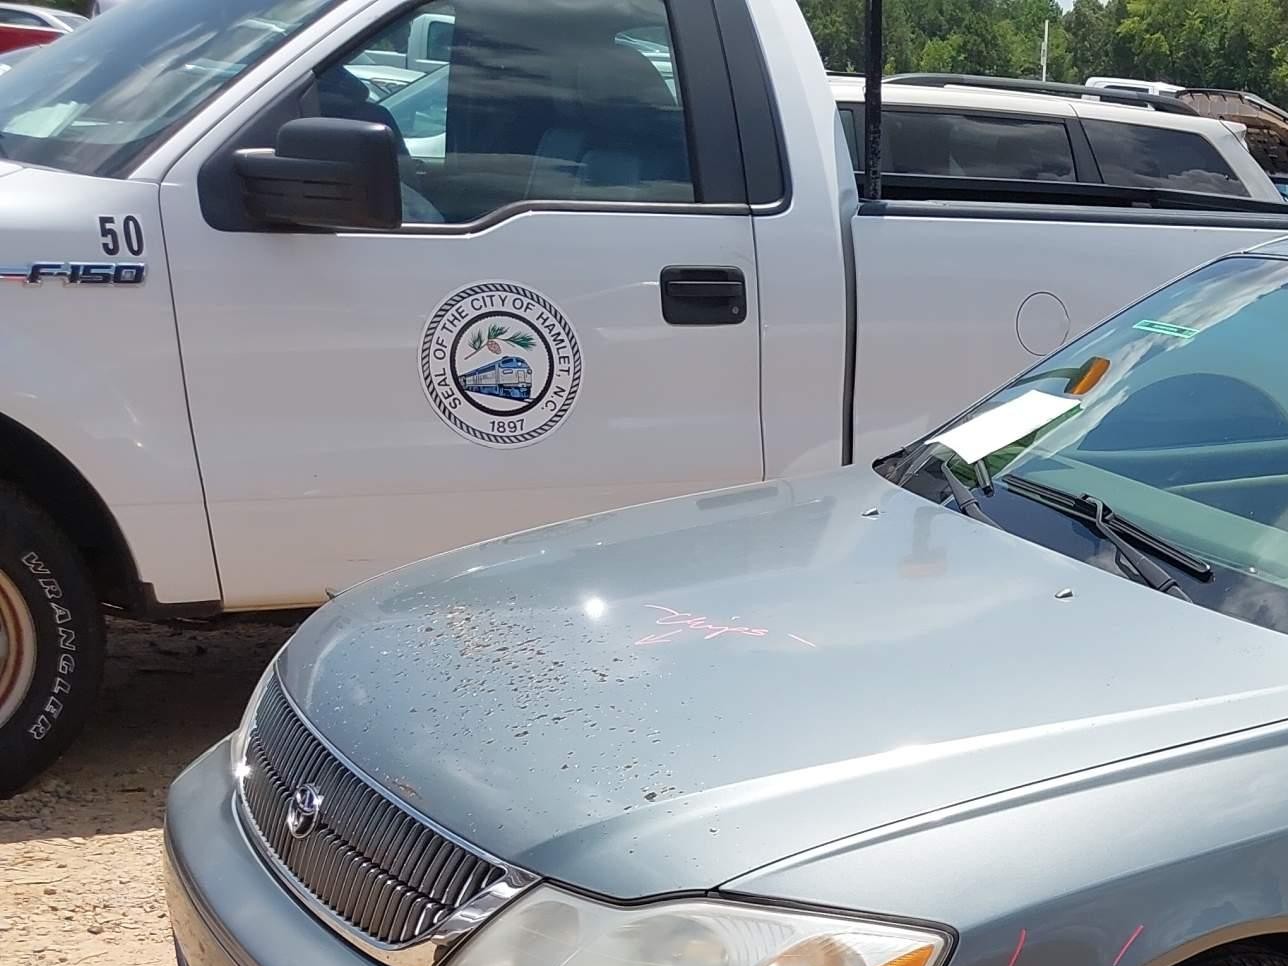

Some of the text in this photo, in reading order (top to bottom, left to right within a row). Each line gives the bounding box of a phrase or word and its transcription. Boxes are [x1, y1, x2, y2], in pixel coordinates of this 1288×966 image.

[98, 215, 144, 256] 50
[433, 294, 571, 412] SEAL OF THE CITY OF HAMLET, N.C.
[489, 418, 525, 433] 1897
[21, 551, 77, 740] WRANGLER
